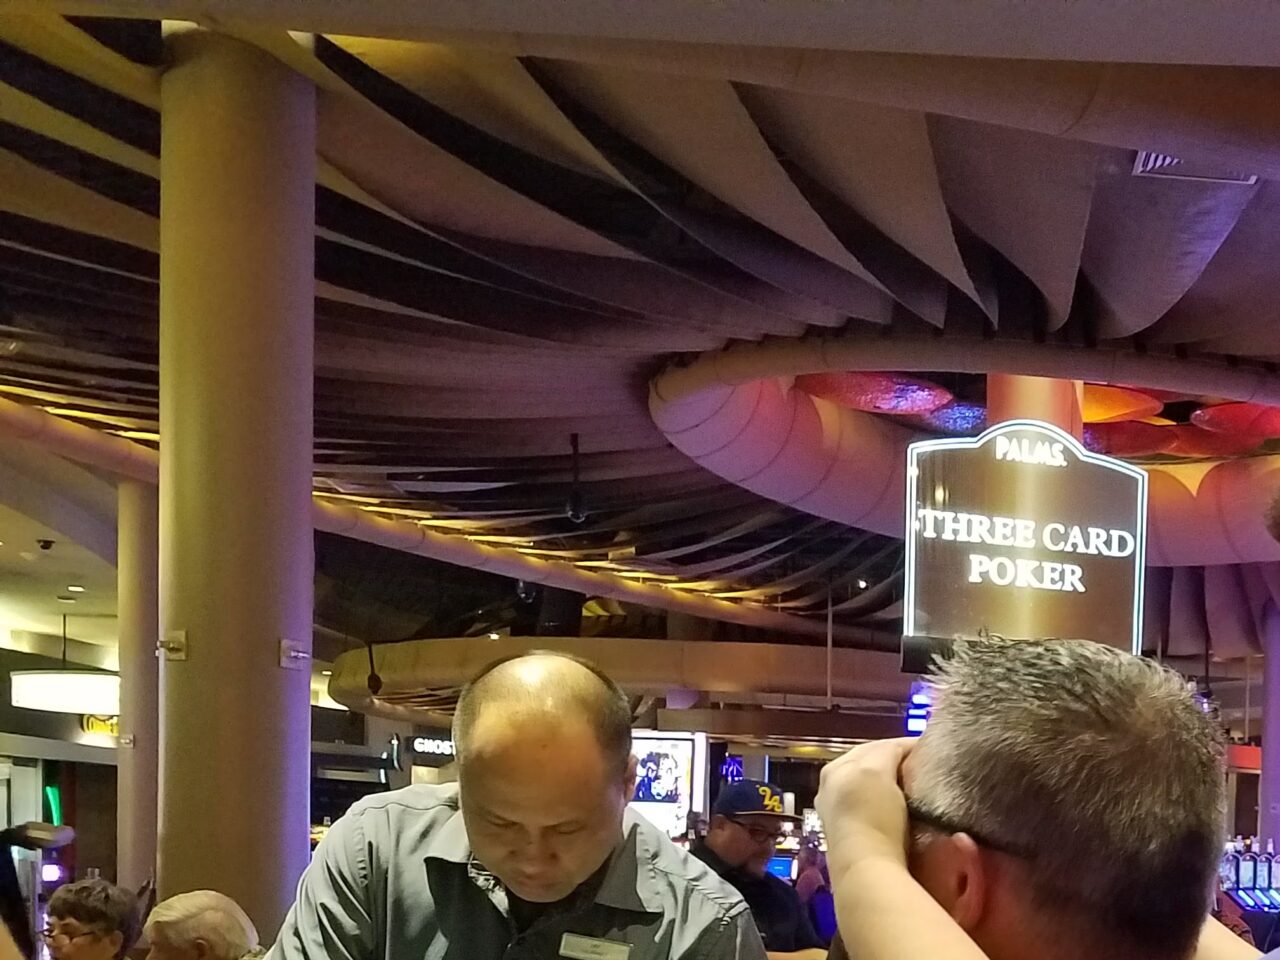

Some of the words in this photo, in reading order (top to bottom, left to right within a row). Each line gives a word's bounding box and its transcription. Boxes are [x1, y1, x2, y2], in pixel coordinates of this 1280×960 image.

[918, 508, 1036, 549] THREE
[1042, 523, 1134, 557] CARD
[968, 554, 1086, 592] POKER
